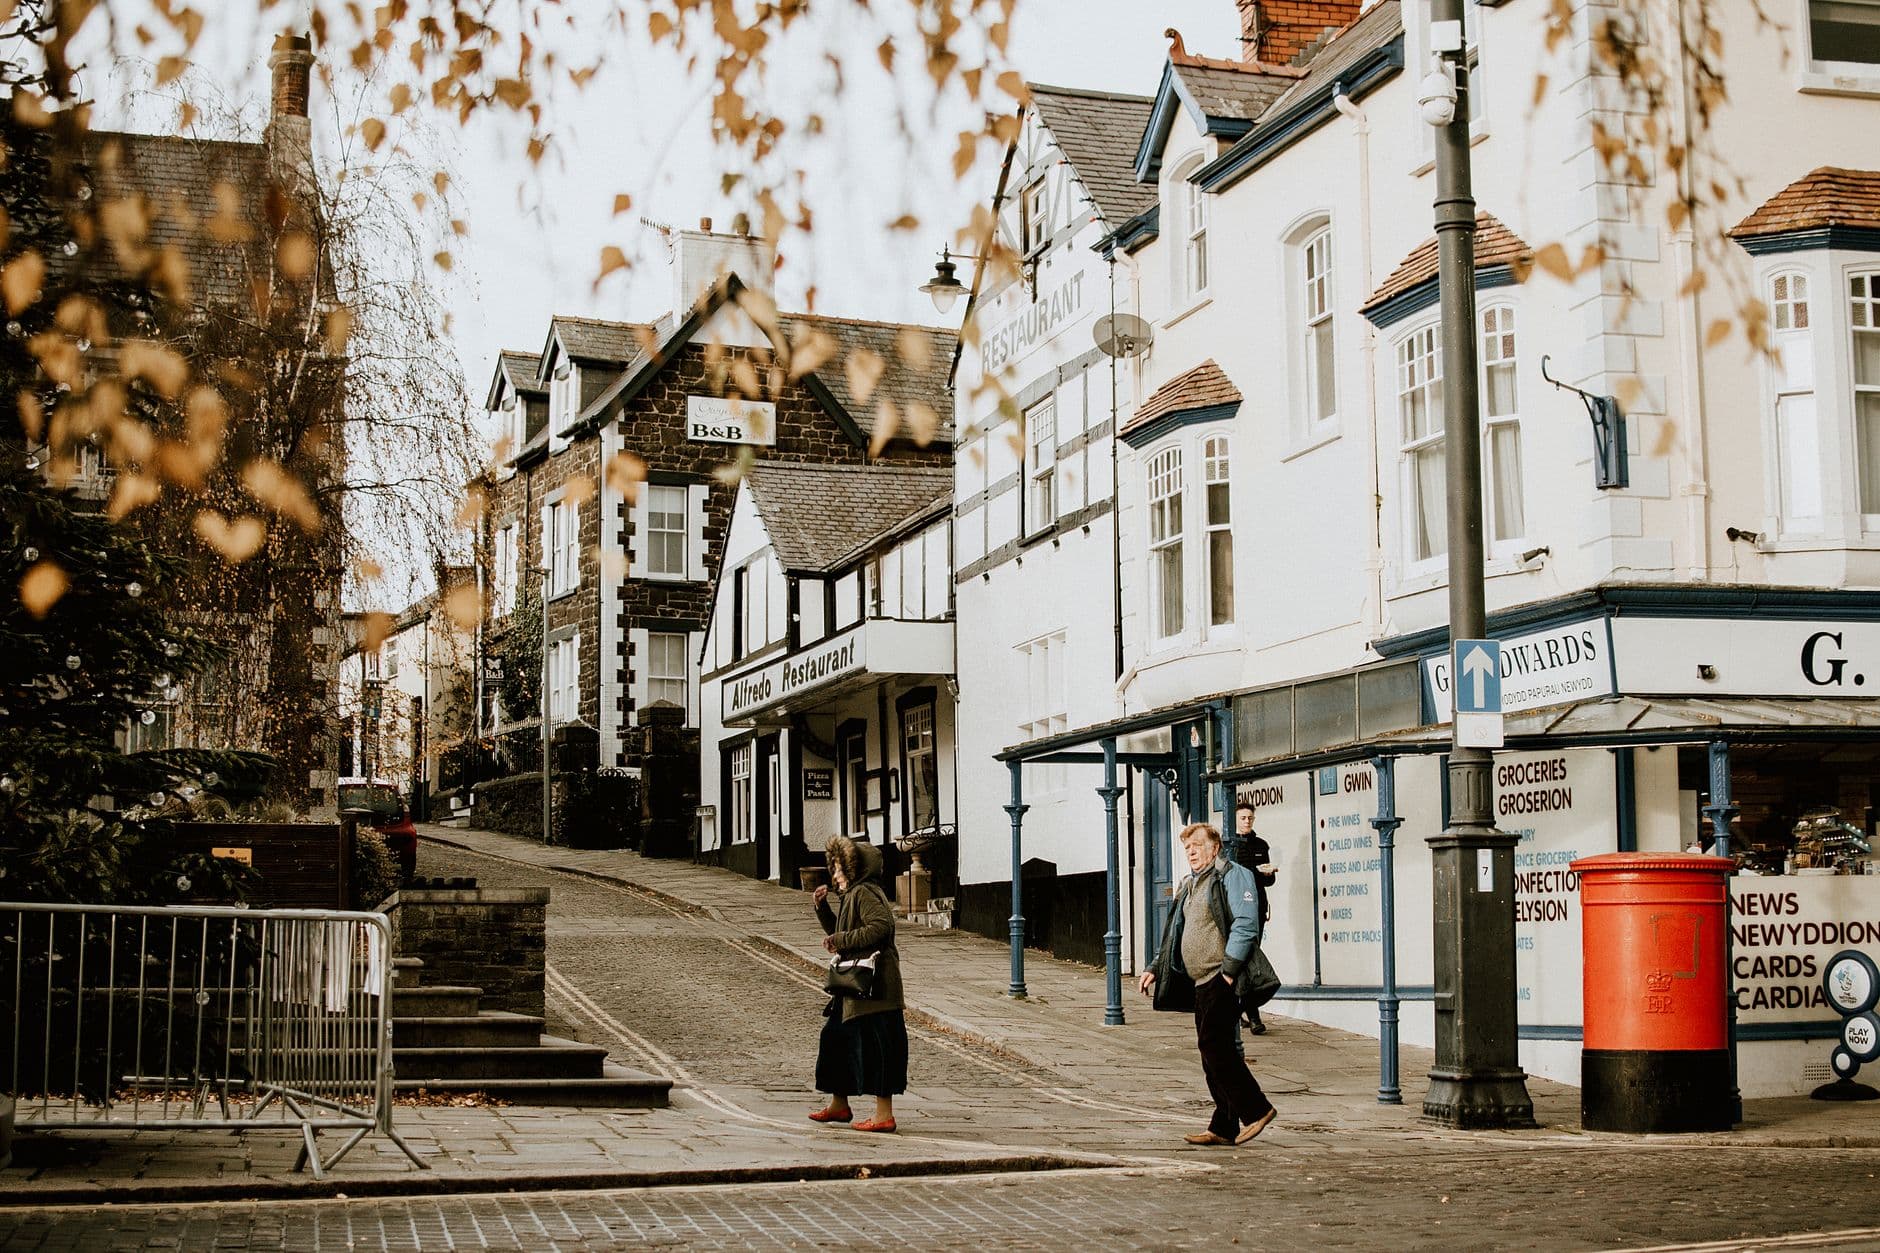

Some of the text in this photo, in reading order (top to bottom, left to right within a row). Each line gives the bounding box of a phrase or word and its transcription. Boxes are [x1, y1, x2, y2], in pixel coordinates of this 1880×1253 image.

[982, 269, 1084, 376] RESTAURANT
[692, 423, 742, 440] B&B
[1501, 631, 1596, 679] DWARDS
[1801, 631, 1865, 686] G.
[486, 669, 504, 679] B&B
[732, 636, 854, 711] Alfredo Restaurant
[1561, 677, 1593, 694] NEWYDD
[808, 772, 829, 780] Pizza
[1498, 758, 1567, 787] GROCERIES
[1344, 771, 1372, 793] GWIN
[808, 789, 830, 797] Pasta
[1238, 785, 1283, 807] EWYDDION
[1499, 787, 1572, 816] GROSERION
[1328, 814, 1360, 828] FINE WINES
[1329, 836, 1372, 851] CHILLED WINES
[1330, 862, 1347, 874] BEERS
[1348, 860, 1361, 873] AND
[1515, 850, 1578, 867] ENCE GROCERIES
[1482, 866, 1489, 876] 7
[1330, 884, 1368, 897] SOFT DRINKS
[1514, 870, 1582, 894] ONFECTION
[1515, 899, 1568, 922] ELYSION
[1730, 892, 1799, 916] NEWS
[1331, 908, 1352, 920] MIXERS
[1331, 930, 1382, 943] PARTY ICE PACKS
[1731, 921, 1880, 947] NEWYDDION
[1733, 955, 1817, 979] CARDS
[1735, 985, 1829, 1010] CARDIA
[1848, 1027, 1869, 1036] PLAY
[1848, 1036, 1869, 1045] NOW
